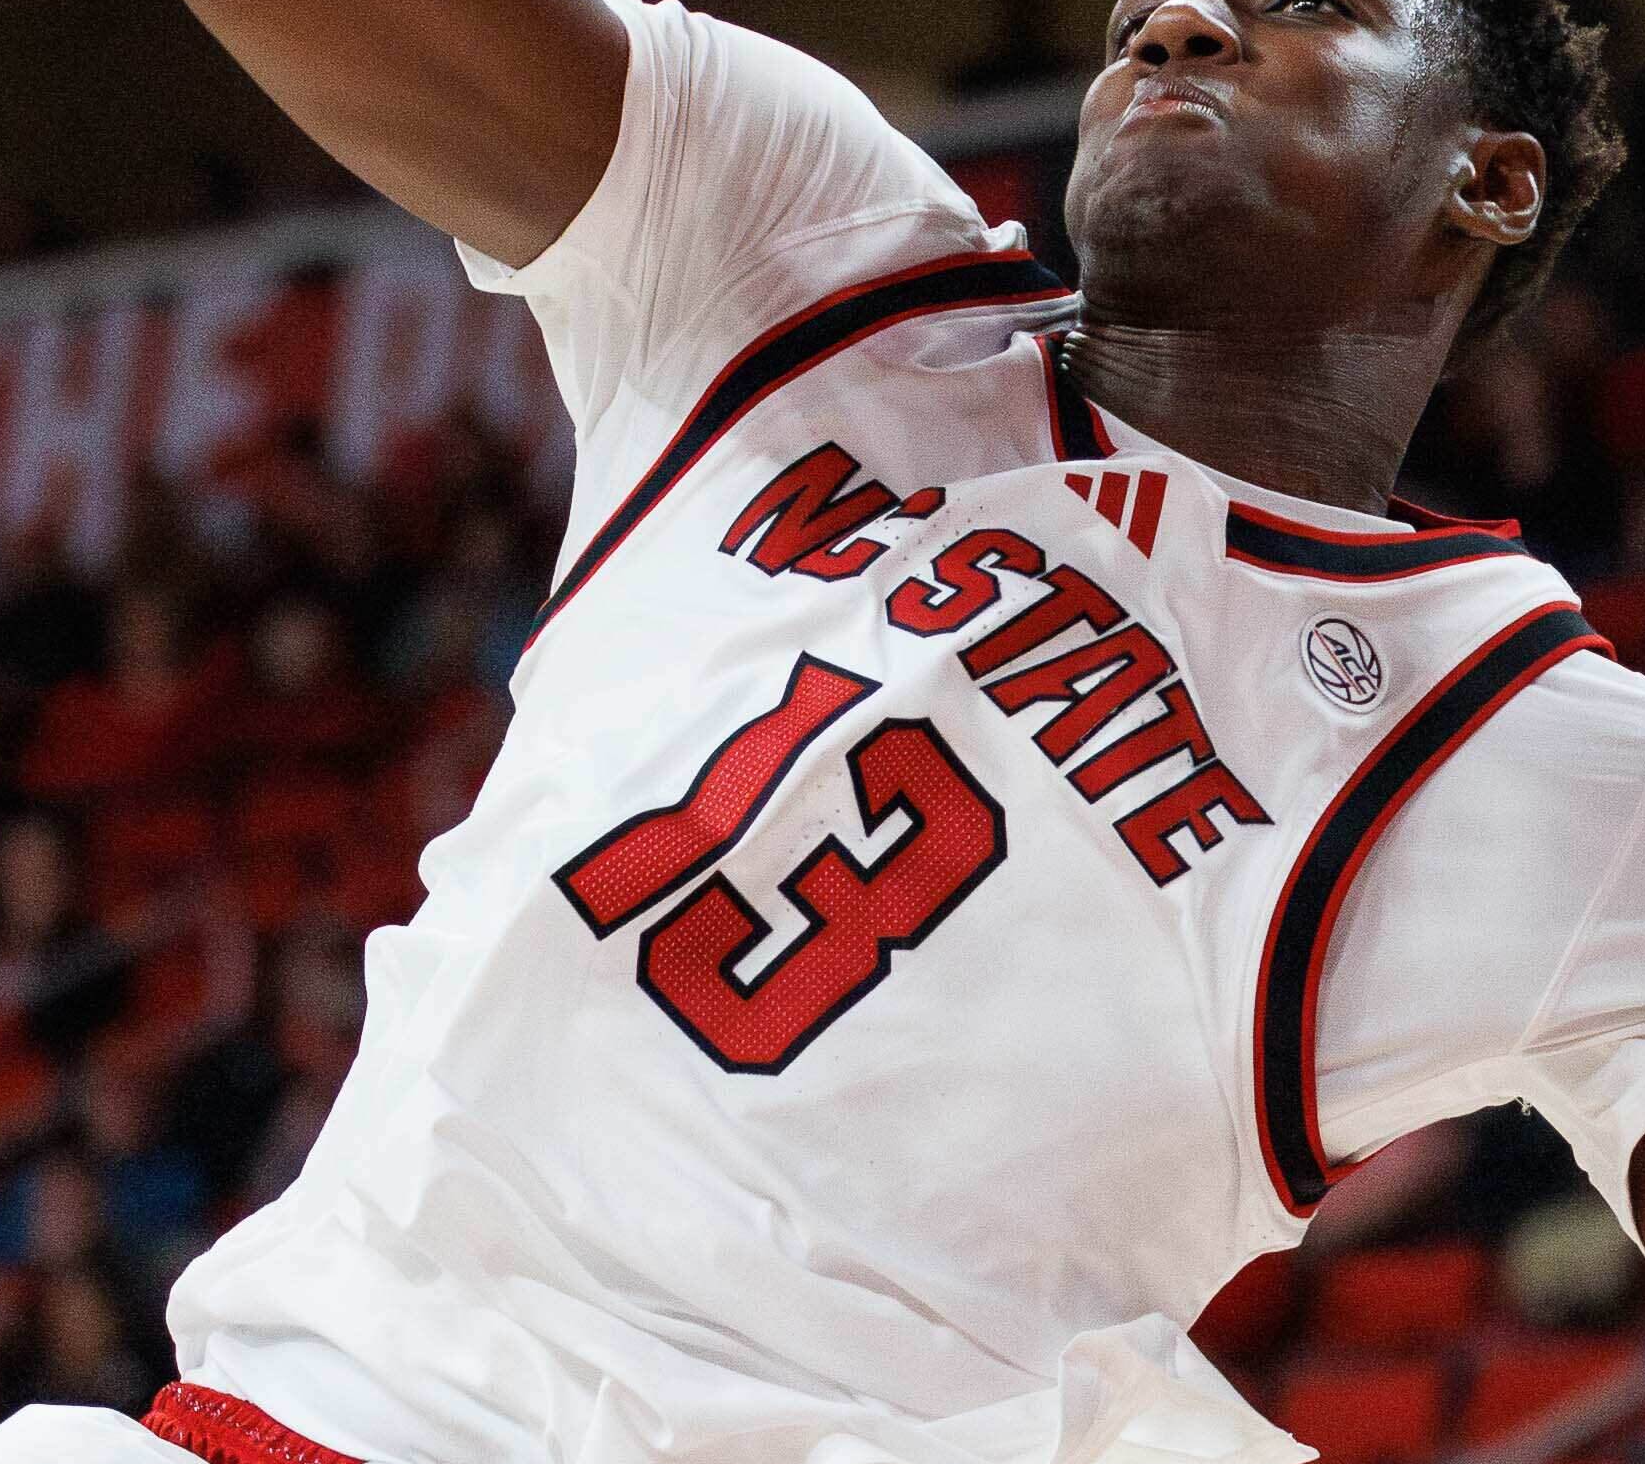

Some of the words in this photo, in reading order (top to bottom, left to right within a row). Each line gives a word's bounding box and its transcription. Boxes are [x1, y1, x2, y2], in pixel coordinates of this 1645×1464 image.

[551, 651, 1008, 1076] 13
[717, 441, 946, 582] NC
[885, 528, 1275, 888] STATE
[1320, 632, 1378, 696] ACC
